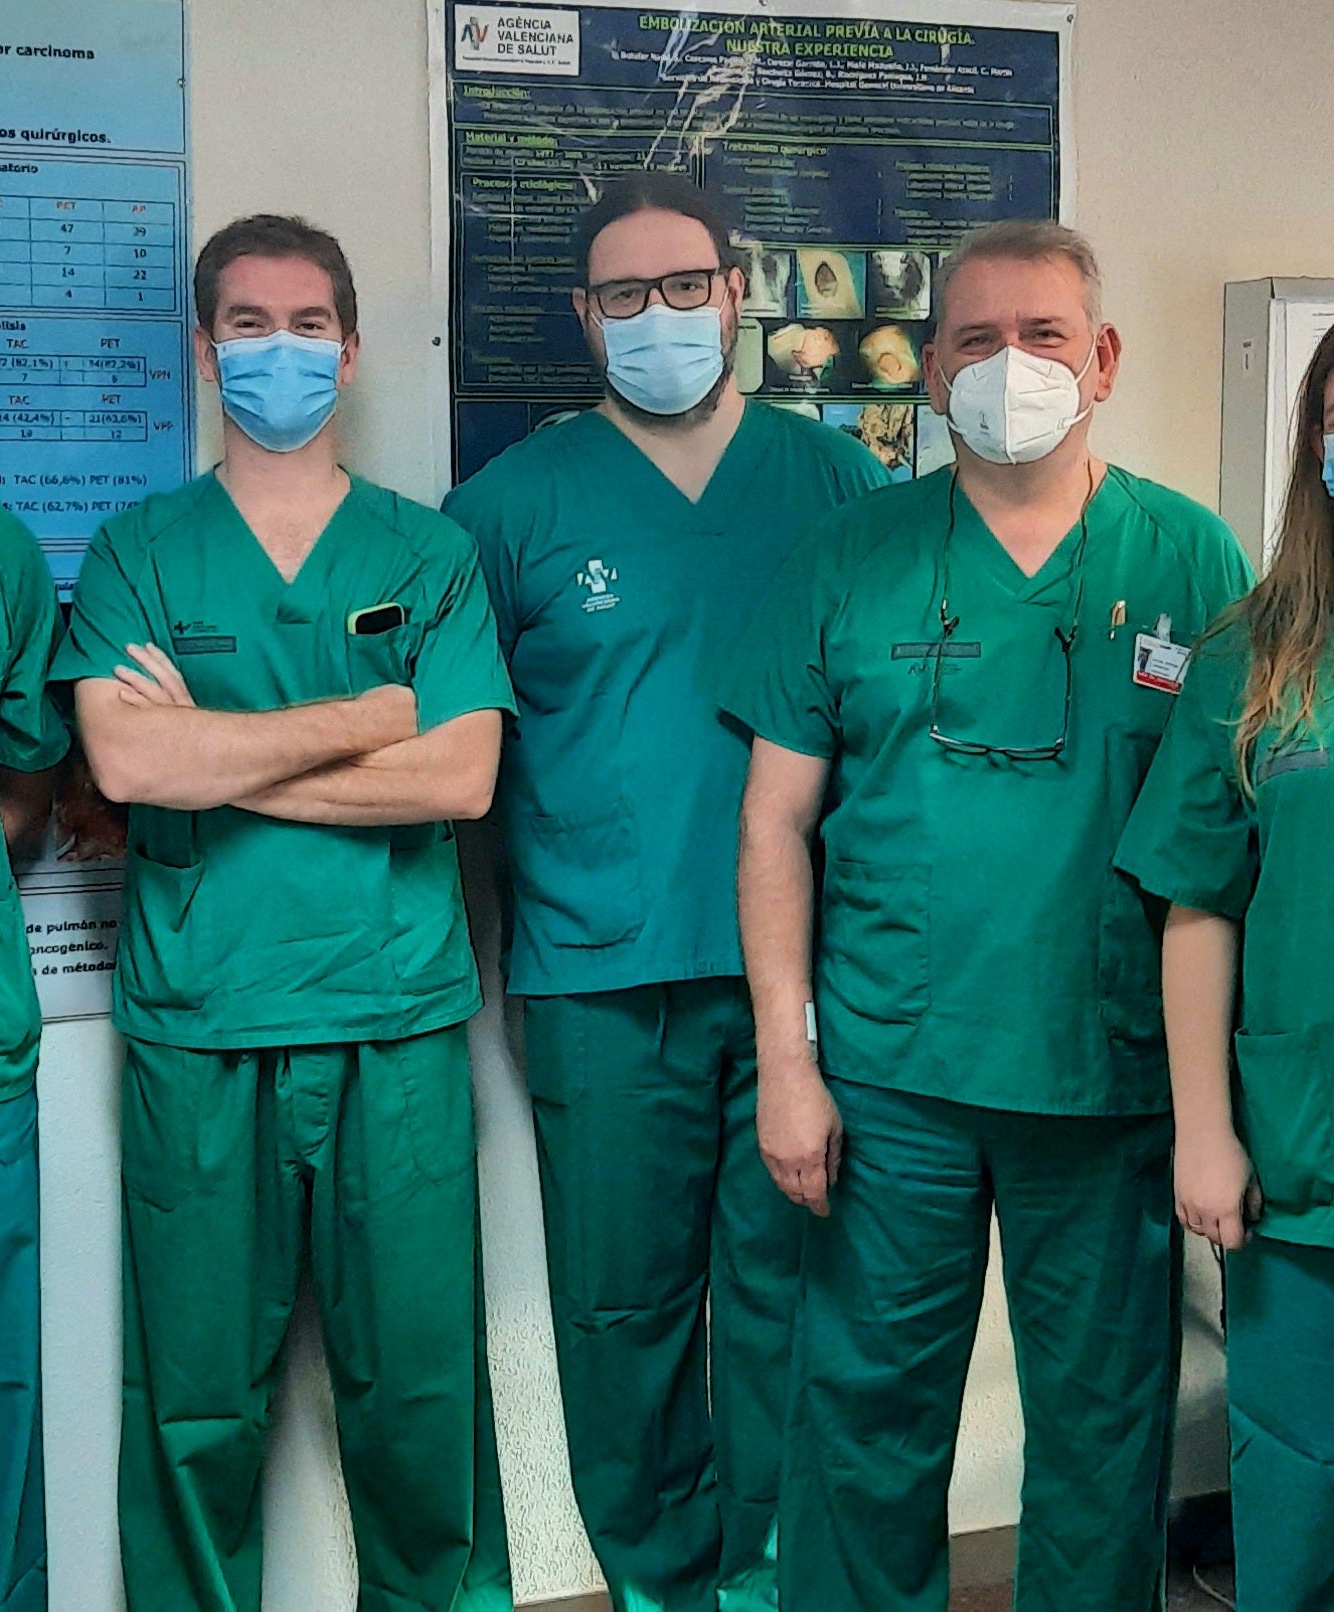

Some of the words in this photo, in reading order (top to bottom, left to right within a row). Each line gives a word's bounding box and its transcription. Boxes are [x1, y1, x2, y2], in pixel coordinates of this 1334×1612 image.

[750, 21, 822, 38] ARTERIAL
[883, 27, 893, 40] A
[896, 28, 912, 40] LA
[497, 31, 574, 44] VALENCIANA
[16, 45, 96, 60] carcinoma
[497, 44, 514, 54] DE
[517, 44, 557, 56] SALUT
[726, 39, 791, 56] NUESTRA
[794, 42, 894, 58] EXPERIENCIA
[20, 128, 112, 144] quirúrgicos.
[60, 223, 74, 233] 47
[134, 249, 147, 259] 10
[13, 475, 36, 485] TAC
[89, 475, 111, 485] PET
[16, 501, 38, 512] TAC
[91, 502, 112, 512] PET
[46, 920, 97, 936] pulmón
[100, 919, 118, 928] no
[41, 964, 58, 975] de
